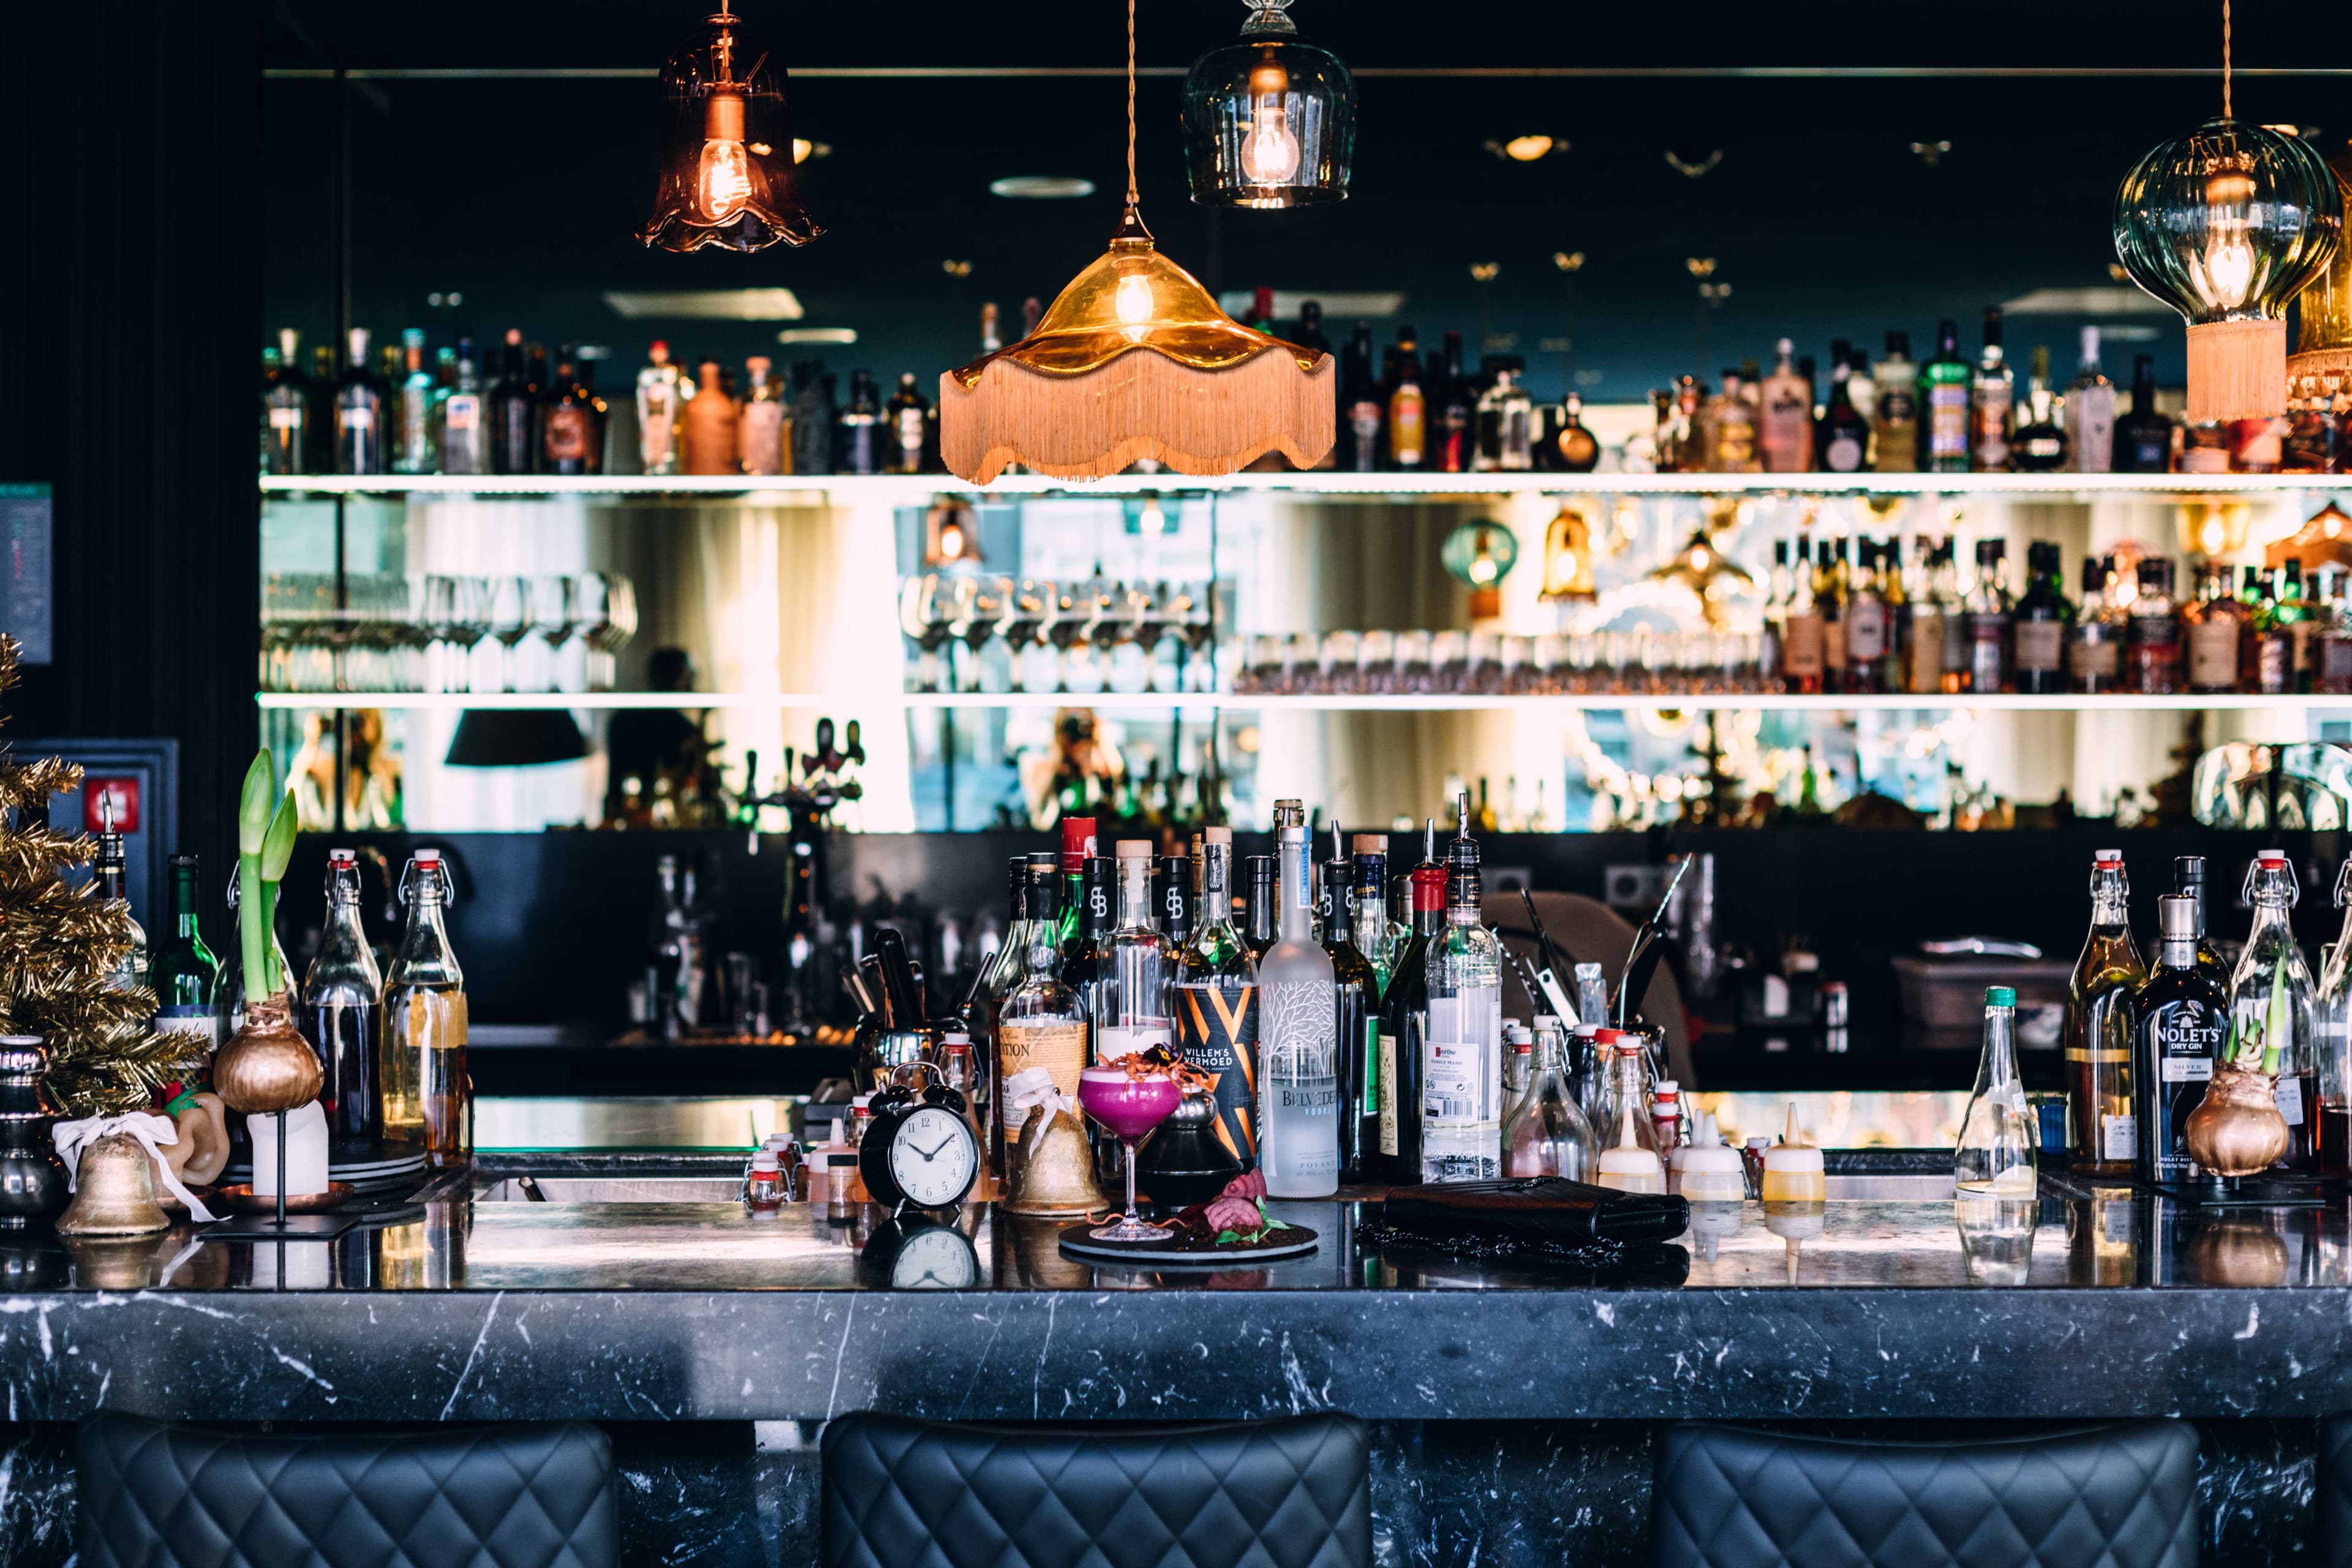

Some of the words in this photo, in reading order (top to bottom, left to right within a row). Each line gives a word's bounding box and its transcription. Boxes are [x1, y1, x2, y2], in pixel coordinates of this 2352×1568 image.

[1356, 886, 1376, 894] APEROL
[2157, 1027, 2222, 1042] NOLET'S
[1186, 1048, 1229, 1057] WILLEM'S
[1184, 1057, 1232, 1066] VERMOED
[921, 1117, 930, 1127] 12
[938, 1121, 941, 1131] 1
[908, 1123, 915, 1133] 11
[898, 1136, 906, 1146] 10
[950, 1133, 956, 1142] 2
[893, 1155, 899, 1164] 9
[955, 1152, 960, 1161] 3
[899, 1171, 904, 1182] 8
[951, 1169, 957, 1177] 4
[911, 1184, 916, 1194] 7
[942, 1182, 948, 1191] 5
[926, 1187, 932, 1197] 6
